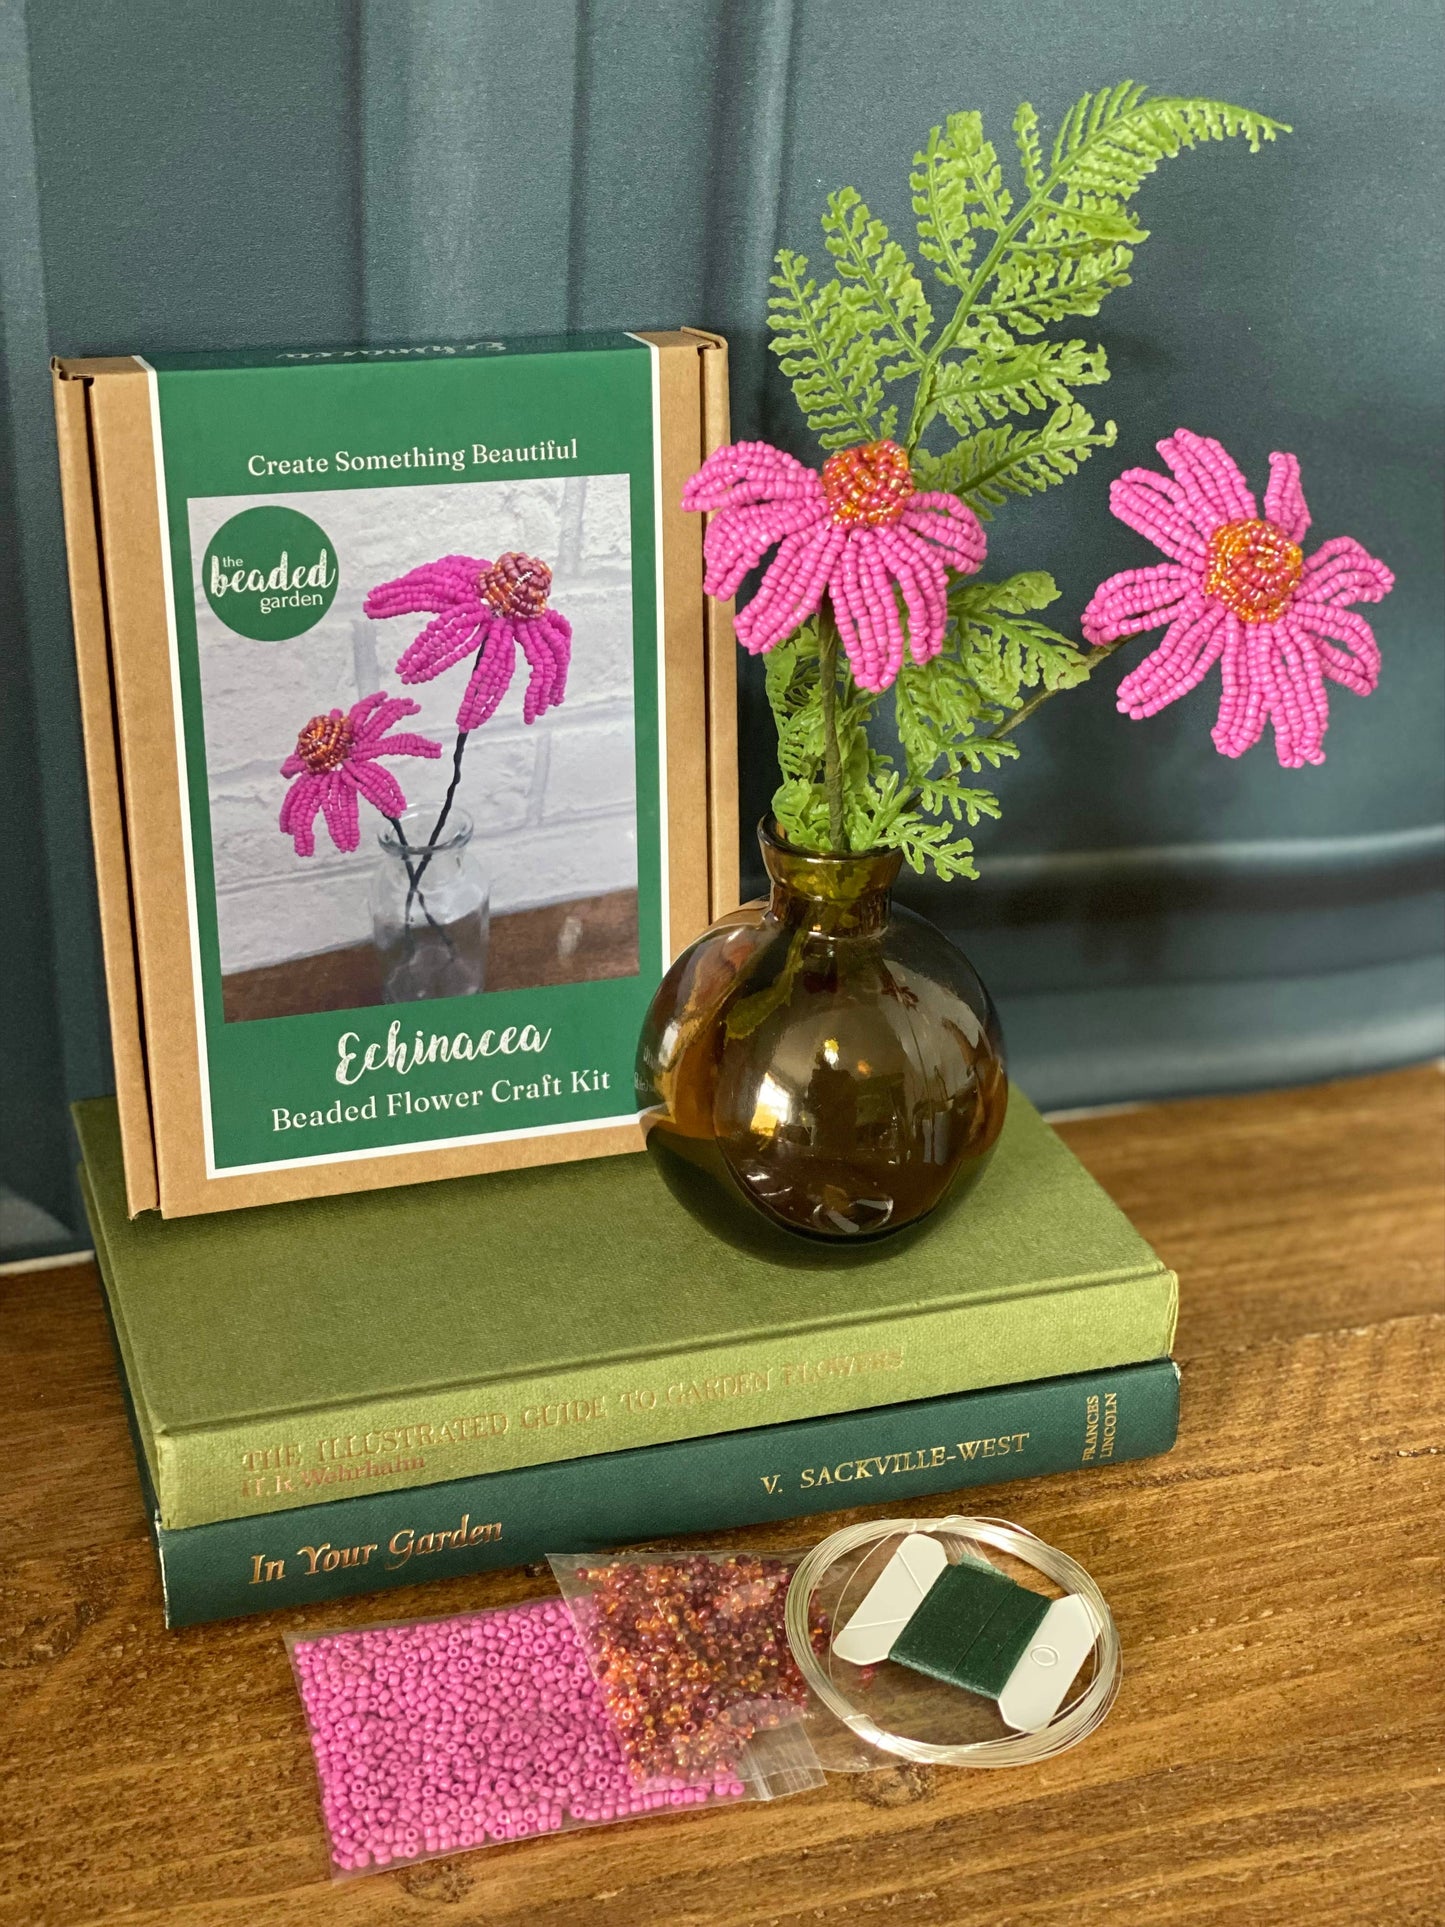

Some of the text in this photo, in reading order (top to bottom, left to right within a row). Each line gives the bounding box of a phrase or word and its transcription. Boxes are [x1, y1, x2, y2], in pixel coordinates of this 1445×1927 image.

[247, 438, 579, 477] Create Something Beautiful
[209, 548, 337, 599] beaded
[222, 556, 244, 569] the
[259, 590, 324, 615] garden
[335, 1020, 552, 1086] Echinacea
[271, 1096, 378, 1132] Beaded
[386, 1087, 484, 1117] Flower
[490, 1073, 563, 1104] Craft
[570, 1069, 611, 1094] Kit
[241, 1349, 904, 1472] THE ILLUSTRATED GUIDE TO GARDEN FLOWERS
[1081, 1394, 1100, 1462] FRANCES
[1099, 1392, 1118, 1459] LINCOLN
[760, 1431, 1031, 1496] V. SACKVILLE-WEST
[248, 1513, 503, 1585] In Your Garden
